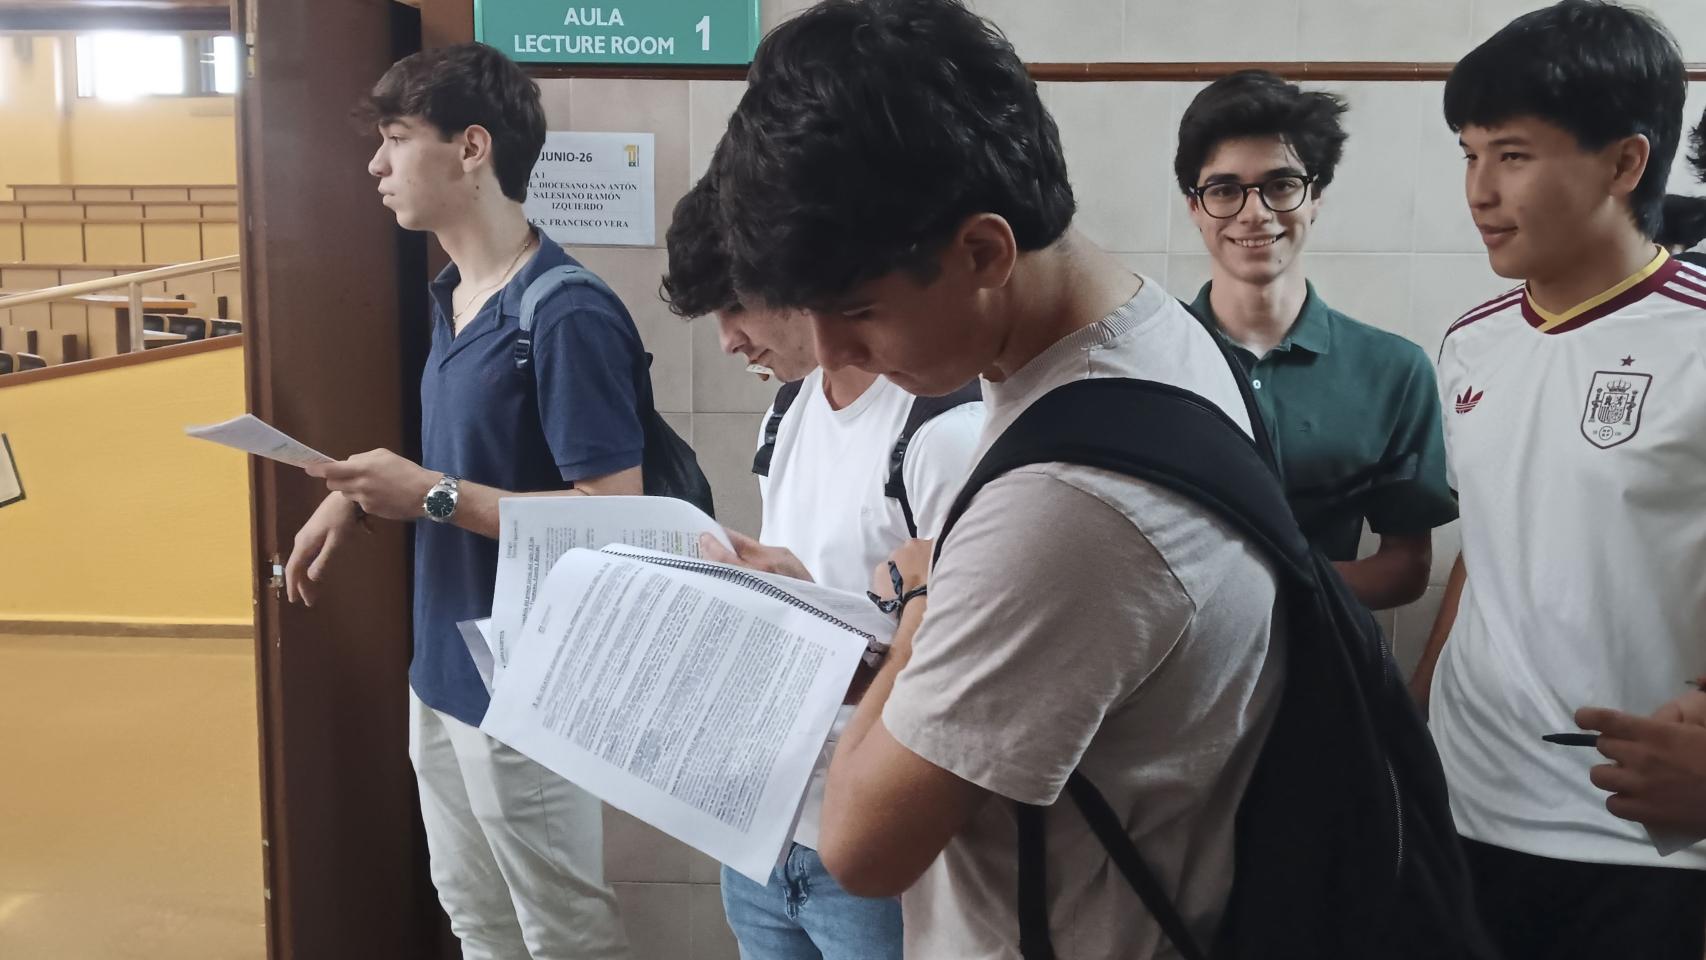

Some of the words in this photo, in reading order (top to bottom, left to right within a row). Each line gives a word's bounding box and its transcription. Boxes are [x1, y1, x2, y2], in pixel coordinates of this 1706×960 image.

[563, 7, 625, 26] AULA
[695, 15, 711, 51] 1
[513, 34, 606, 54] LECTURE
[611, 36, 675, 55] ROOM
[540, 151, 593, 163] JUNIO-26
[539, 181, 588, 189] DIOCESANO
[590, 182, 606, 190] SAN
[609, 182, 637, 191] ANTÓN
[533, 191, 585, 200] SALESIANO
[587, 191, 621, 201] RAMÓN
[552, 202, 603, 211] IZQUIERDO
[549, 219, 602, 227] FRANCISCO
[604, 220, 628, 228] VERA
